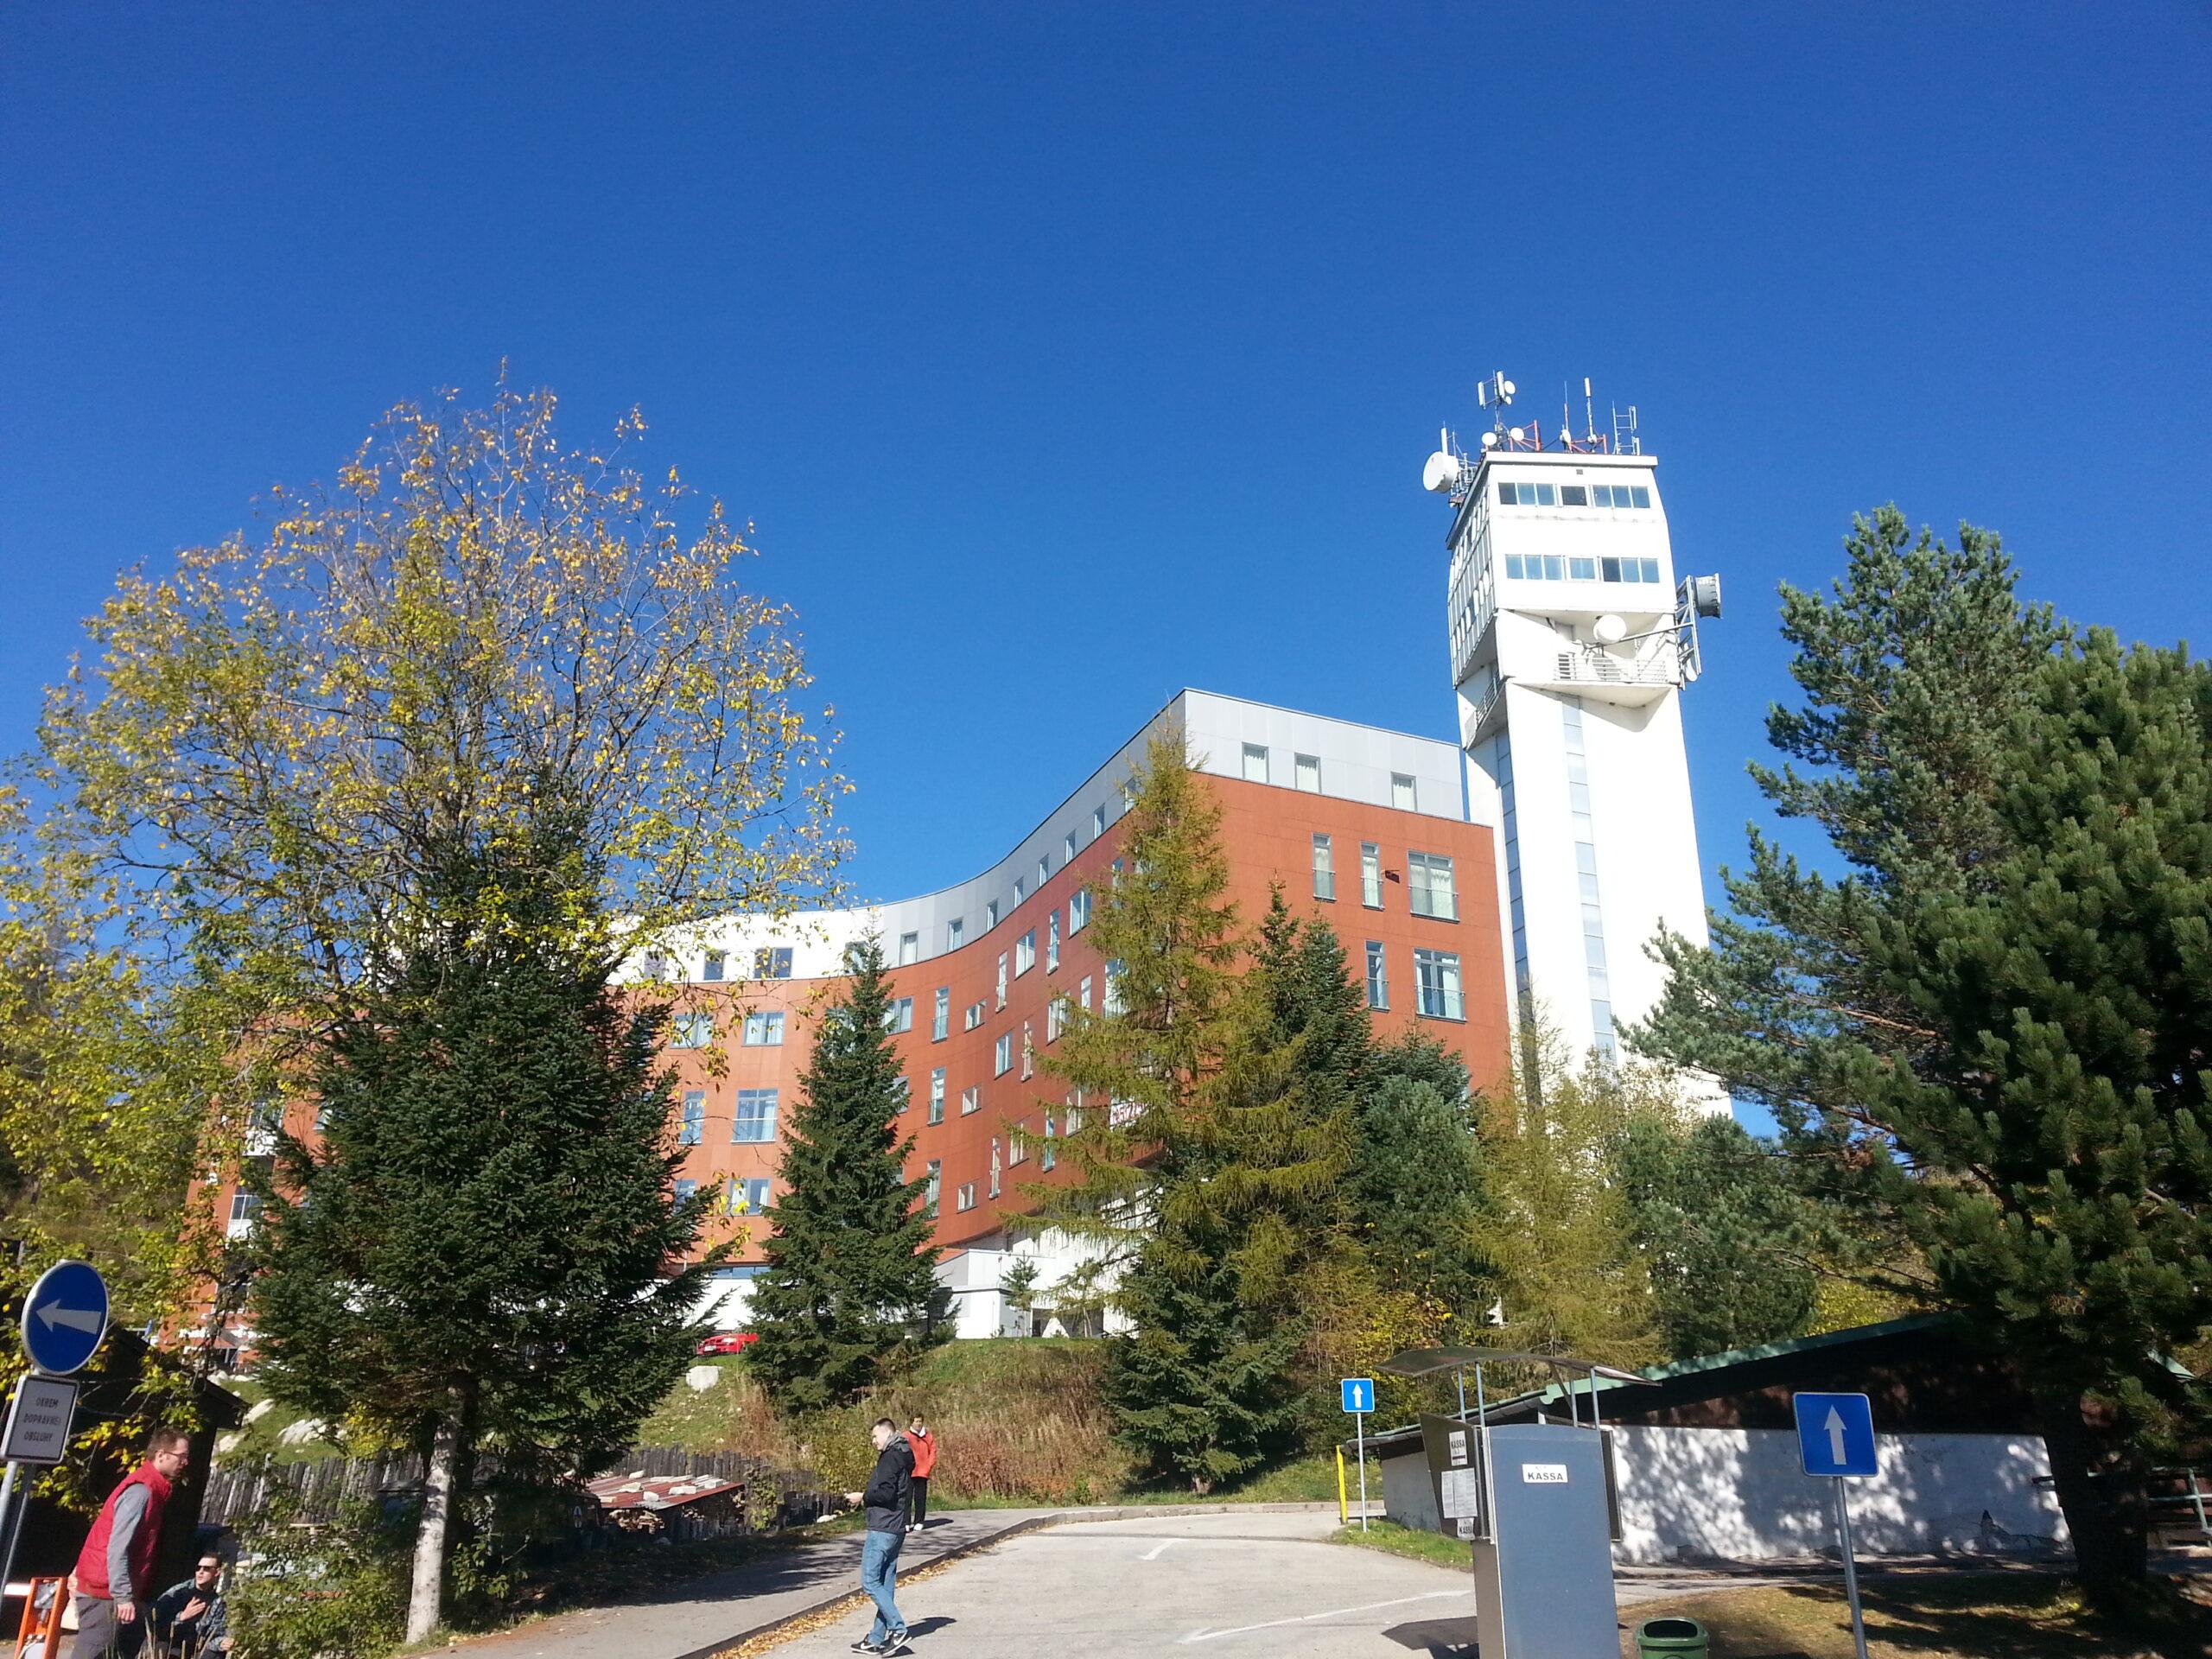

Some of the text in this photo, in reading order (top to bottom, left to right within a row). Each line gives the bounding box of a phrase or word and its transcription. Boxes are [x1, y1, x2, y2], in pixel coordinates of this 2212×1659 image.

[35, 1397, 59, 1408] OKREM
[24, 1431, 53, 1442] OBSLUHY
[1451, 1440, 1465, 1448] KASSA
[1528, 1471, 1564, 1481] KASSA
